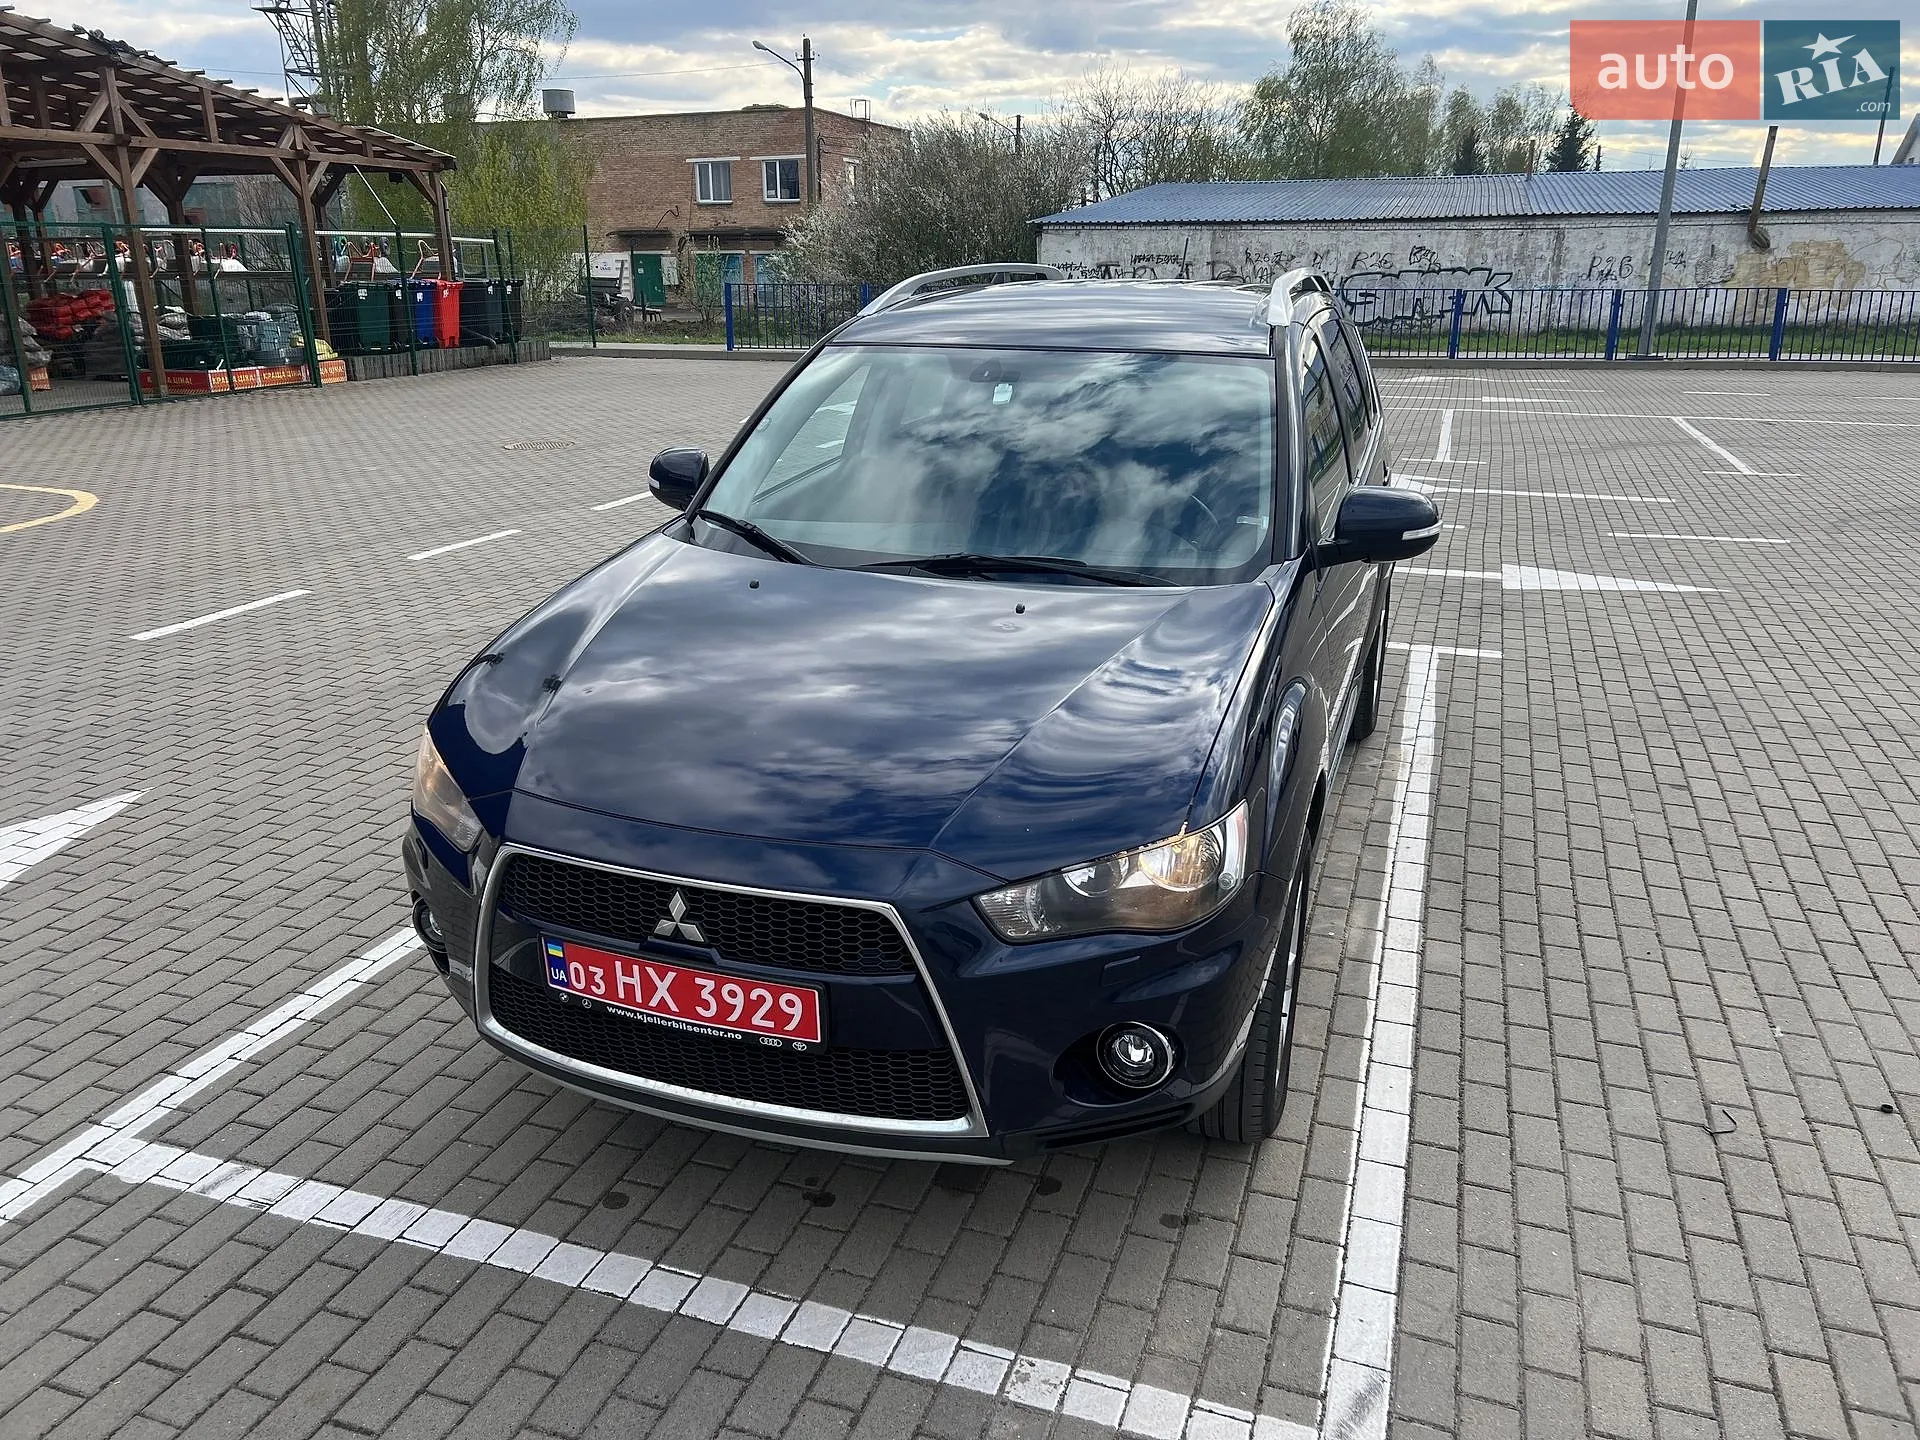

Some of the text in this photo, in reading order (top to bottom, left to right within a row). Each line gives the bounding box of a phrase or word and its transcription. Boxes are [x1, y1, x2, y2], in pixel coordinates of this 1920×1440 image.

[551, 968, 567, 983] UA
[568, 960, 803, 1031] 03 HX 3929
[606, 1005, 743, 1040] www.kjellerbilsenter.no
